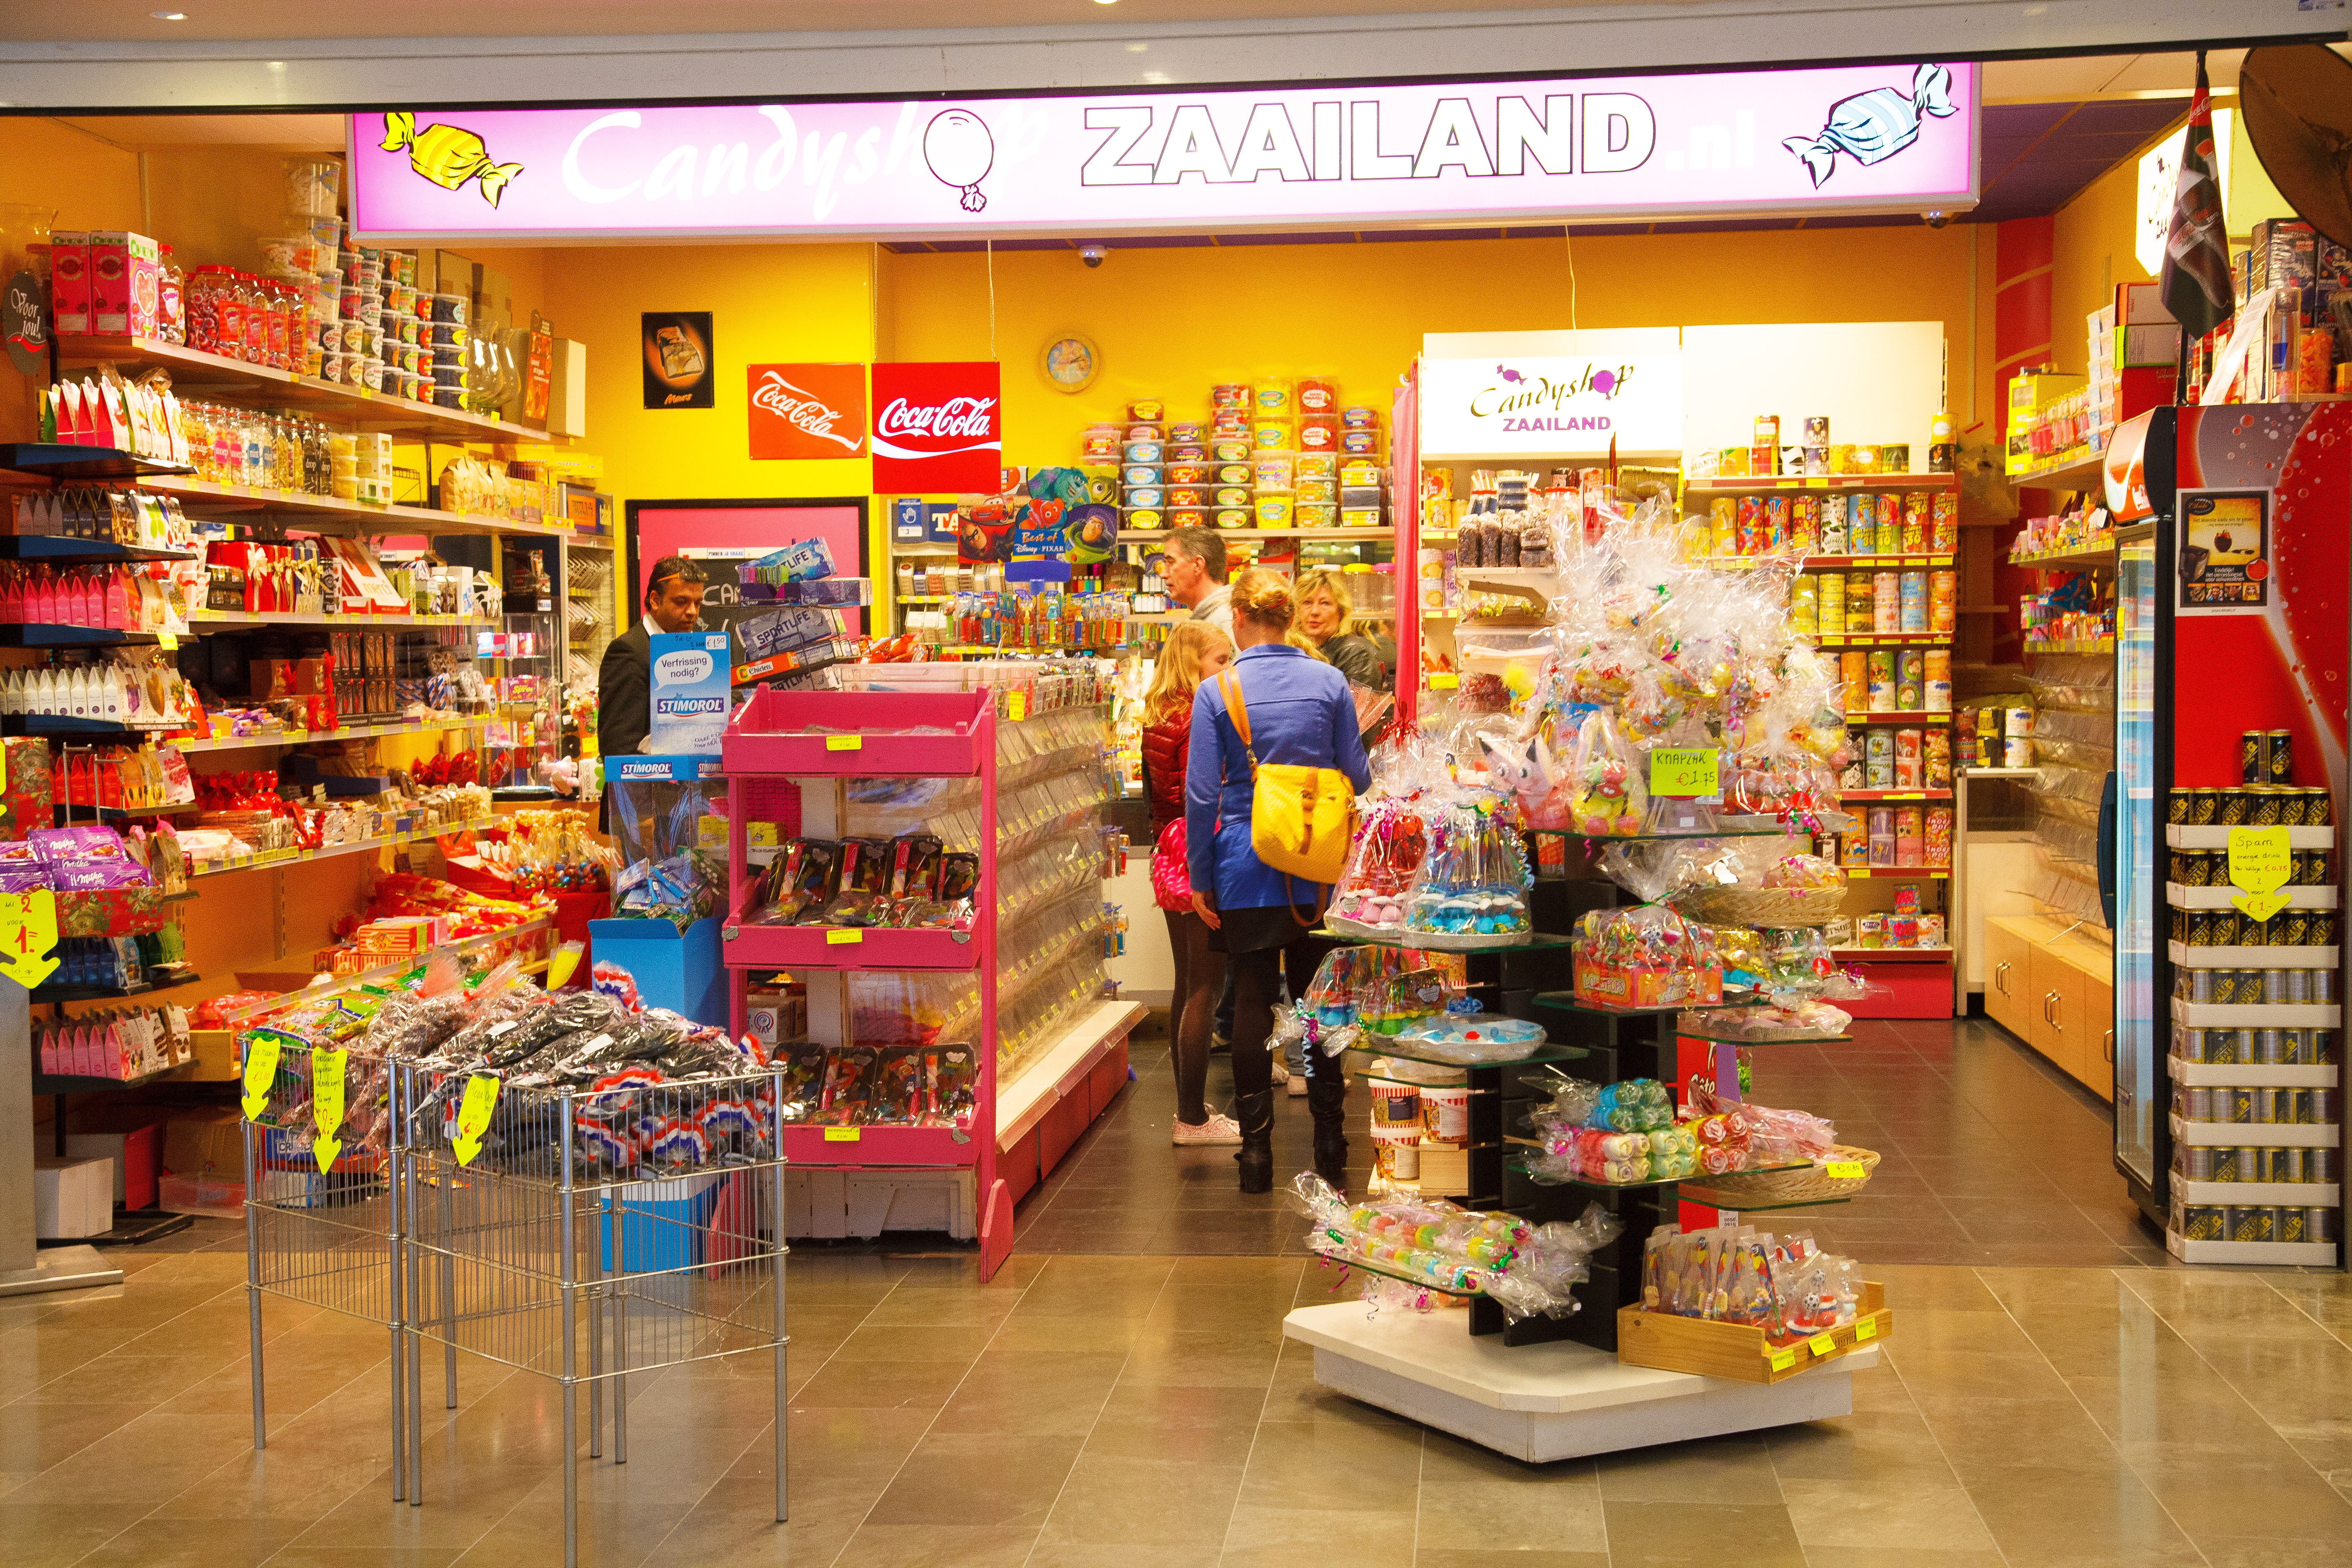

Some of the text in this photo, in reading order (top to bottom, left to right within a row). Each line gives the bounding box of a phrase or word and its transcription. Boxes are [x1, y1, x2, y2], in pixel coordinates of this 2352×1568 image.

[664, 392, 693, 406] Mars
[752, 383, 843, 436] Coca-Cola
[878, 396, 998, 437] Coca-Cola
[1502, 416, 1611, 432] ZAAILAND
[1022, 531, 1057, 543] Best of
[1014, 544, 1037, 554] Disney
[756, 610, 811, 645] SPORTLIFE
[661, 656, 708, 669] Verfrissing
[749, 663, 772, 676] Chiclets
[670, 667, 700, 679] nodig?
[658, 698, 721, 712] STIMOROL
[623, 763, 670, 774] STIMOROL
[2236, 834, 2274, 850] Spam
[21, 895, 32, 913] 2
